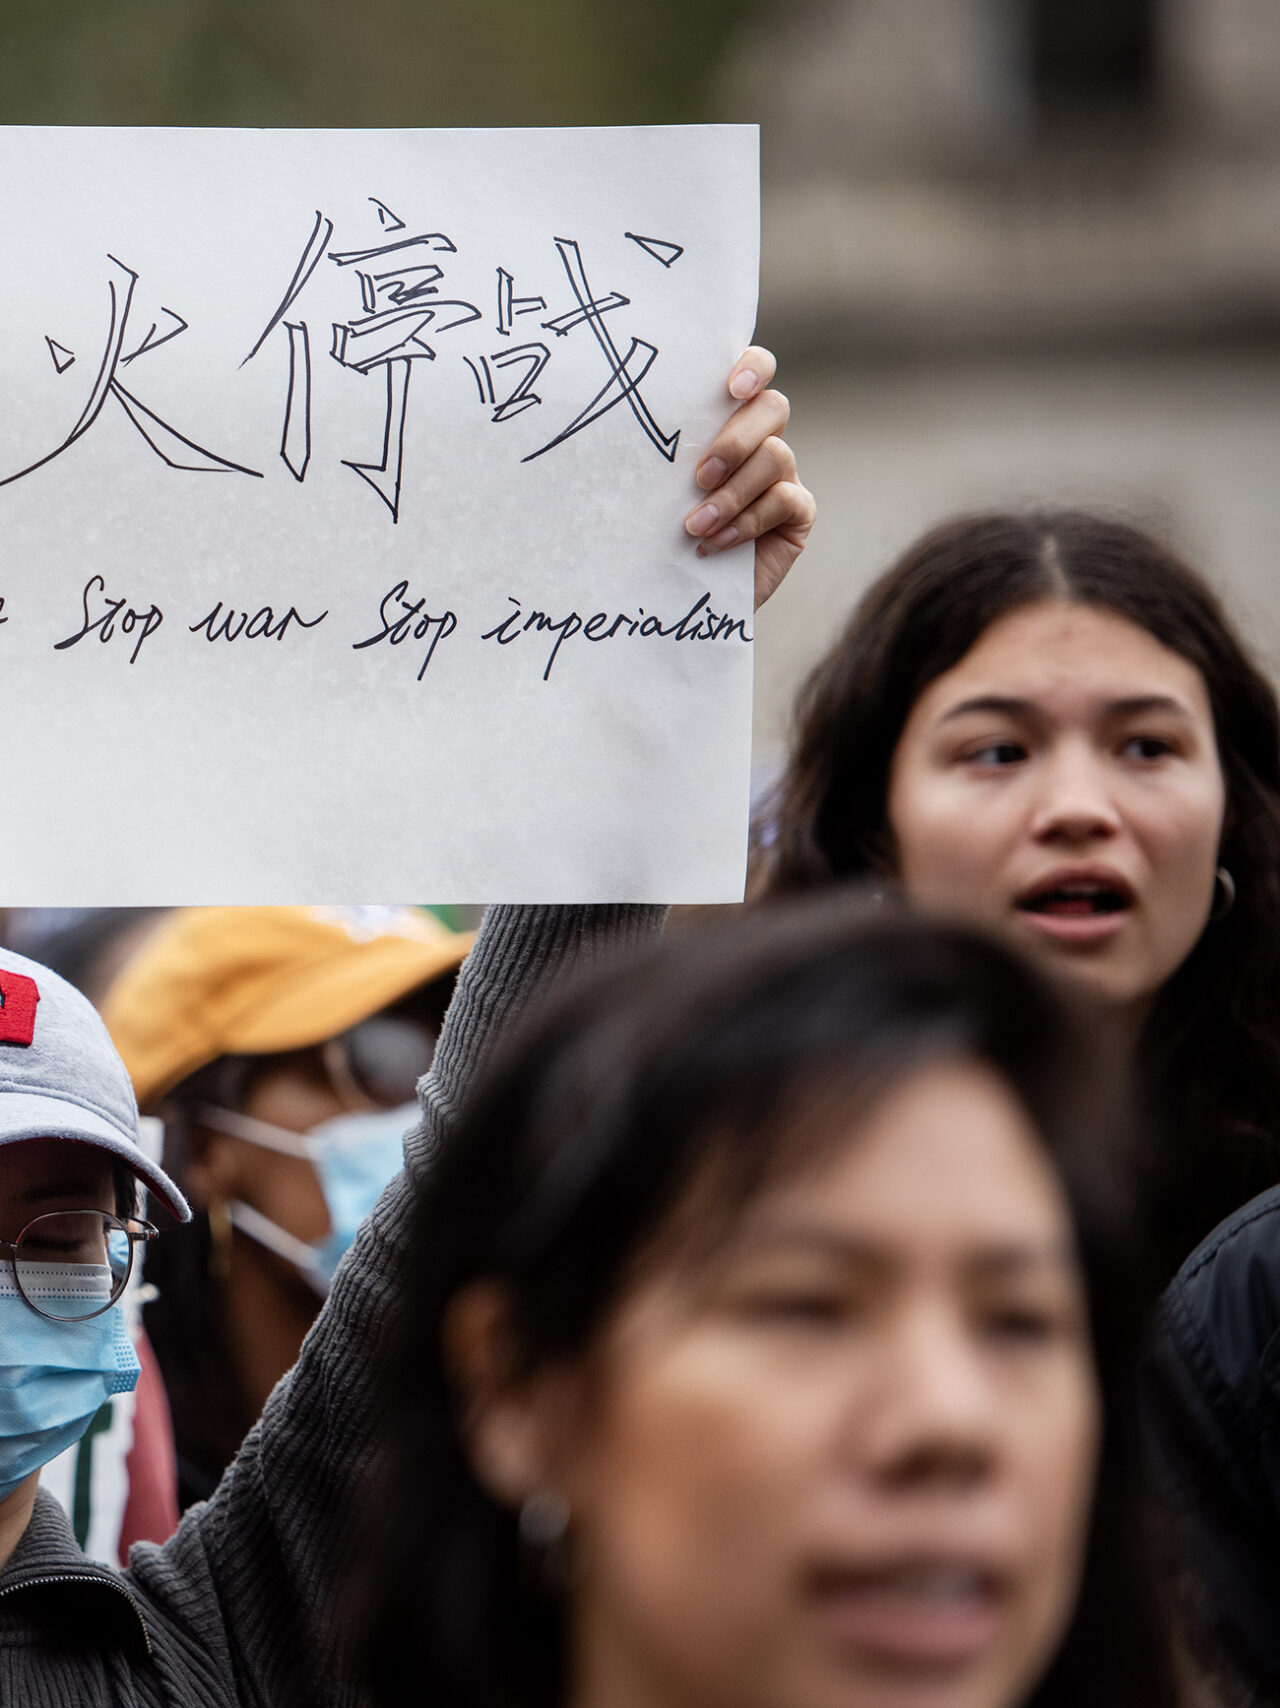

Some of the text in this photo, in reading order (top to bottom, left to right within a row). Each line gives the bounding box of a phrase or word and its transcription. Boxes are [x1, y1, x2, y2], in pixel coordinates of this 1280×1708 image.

[54, 575, 163, 664] Stop
[190, 602, 328, 642] war
[353, 580, 457, 681] Stop
[481, 597, 754, 681] imperialism
